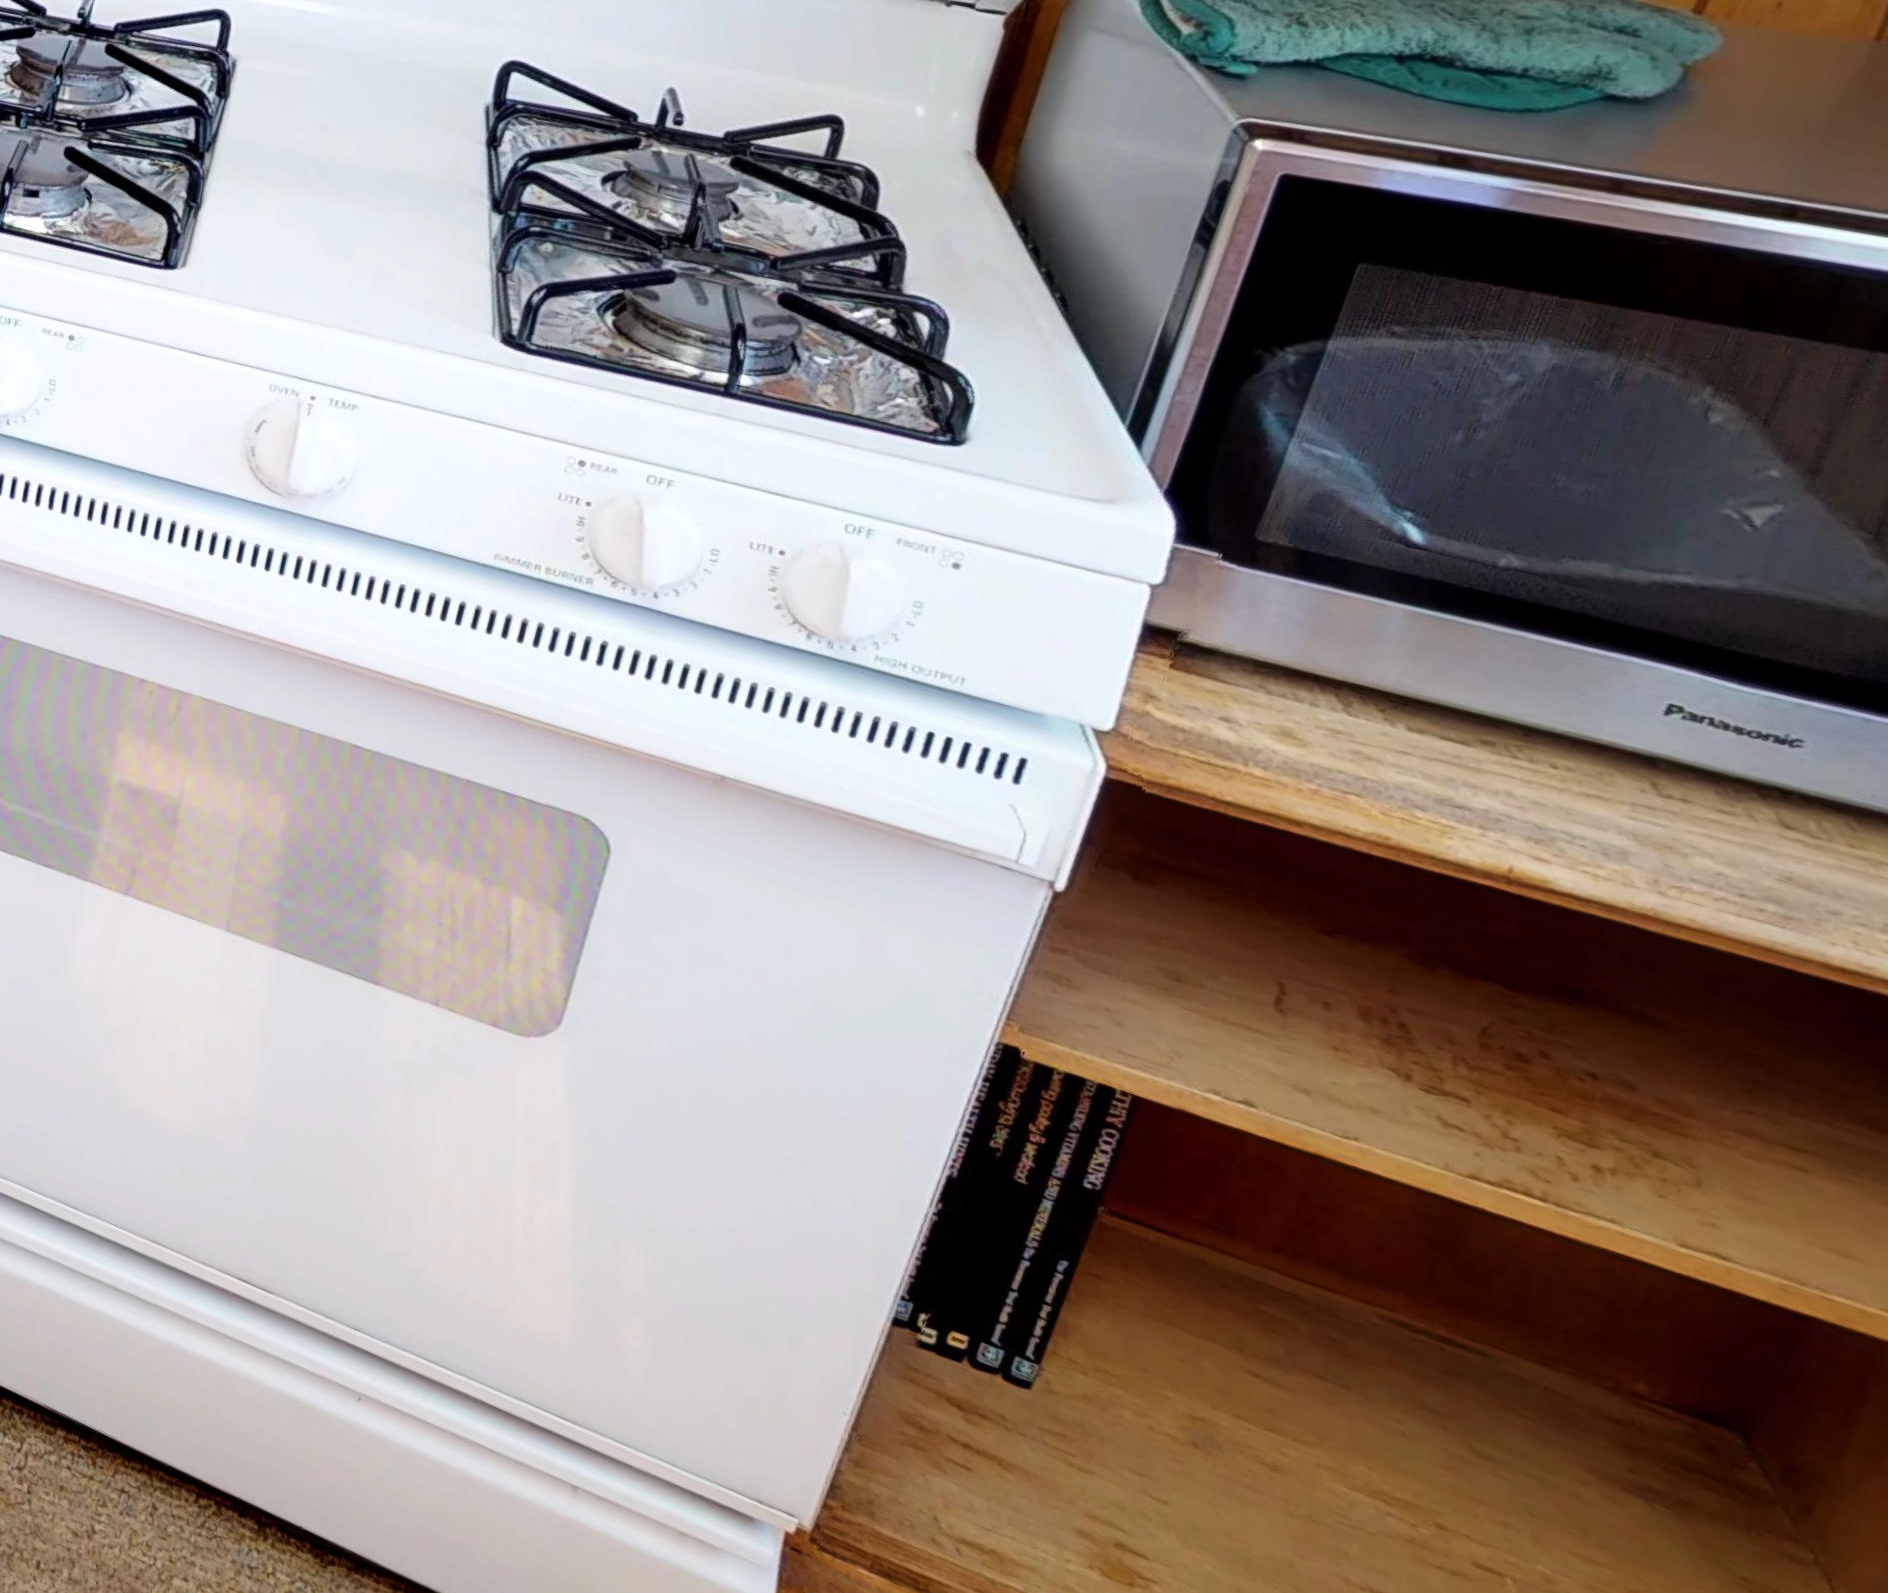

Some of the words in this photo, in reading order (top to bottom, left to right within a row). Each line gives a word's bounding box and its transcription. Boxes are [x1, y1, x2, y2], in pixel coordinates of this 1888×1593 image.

[268, 383, 300, 398] OVEN
[329, 398, 359, 411] TEMP
[589, 462, 619, 475] REAR
[645, 474, 675, 490] OFF
[558, 492, 583, 506] LITE
[844, 523, 875, 539] OFF
[749, 541, 774, 555] LITE
[896, 538, 937, 555] FRONT
[910, 664, 967, 686] OUTPUT
[1663, 703, 1805, 749] Panasonic
[1081, 1124, 1121, 1193] COOKING
